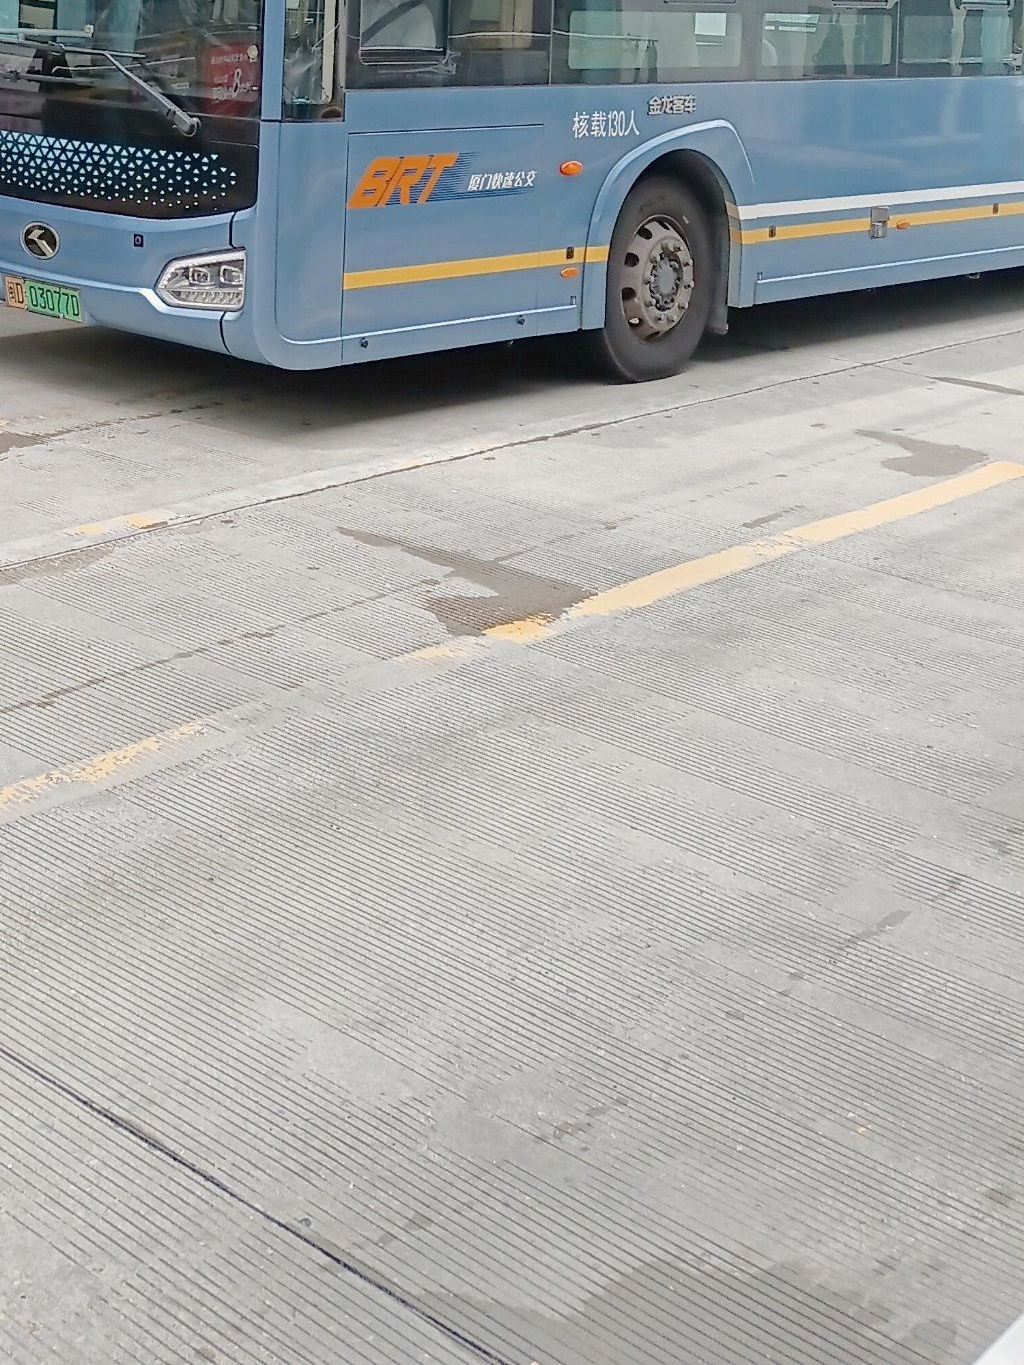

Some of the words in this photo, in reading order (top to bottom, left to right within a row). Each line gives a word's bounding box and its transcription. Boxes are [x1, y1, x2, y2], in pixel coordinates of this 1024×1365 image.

[648, 95, 697, 116] 金龙客车
[572, 110, 640, 139] 核载130人
[347, 153, 459, 209] BRT
[467, 170, 538, 191] 厦门快速公交
